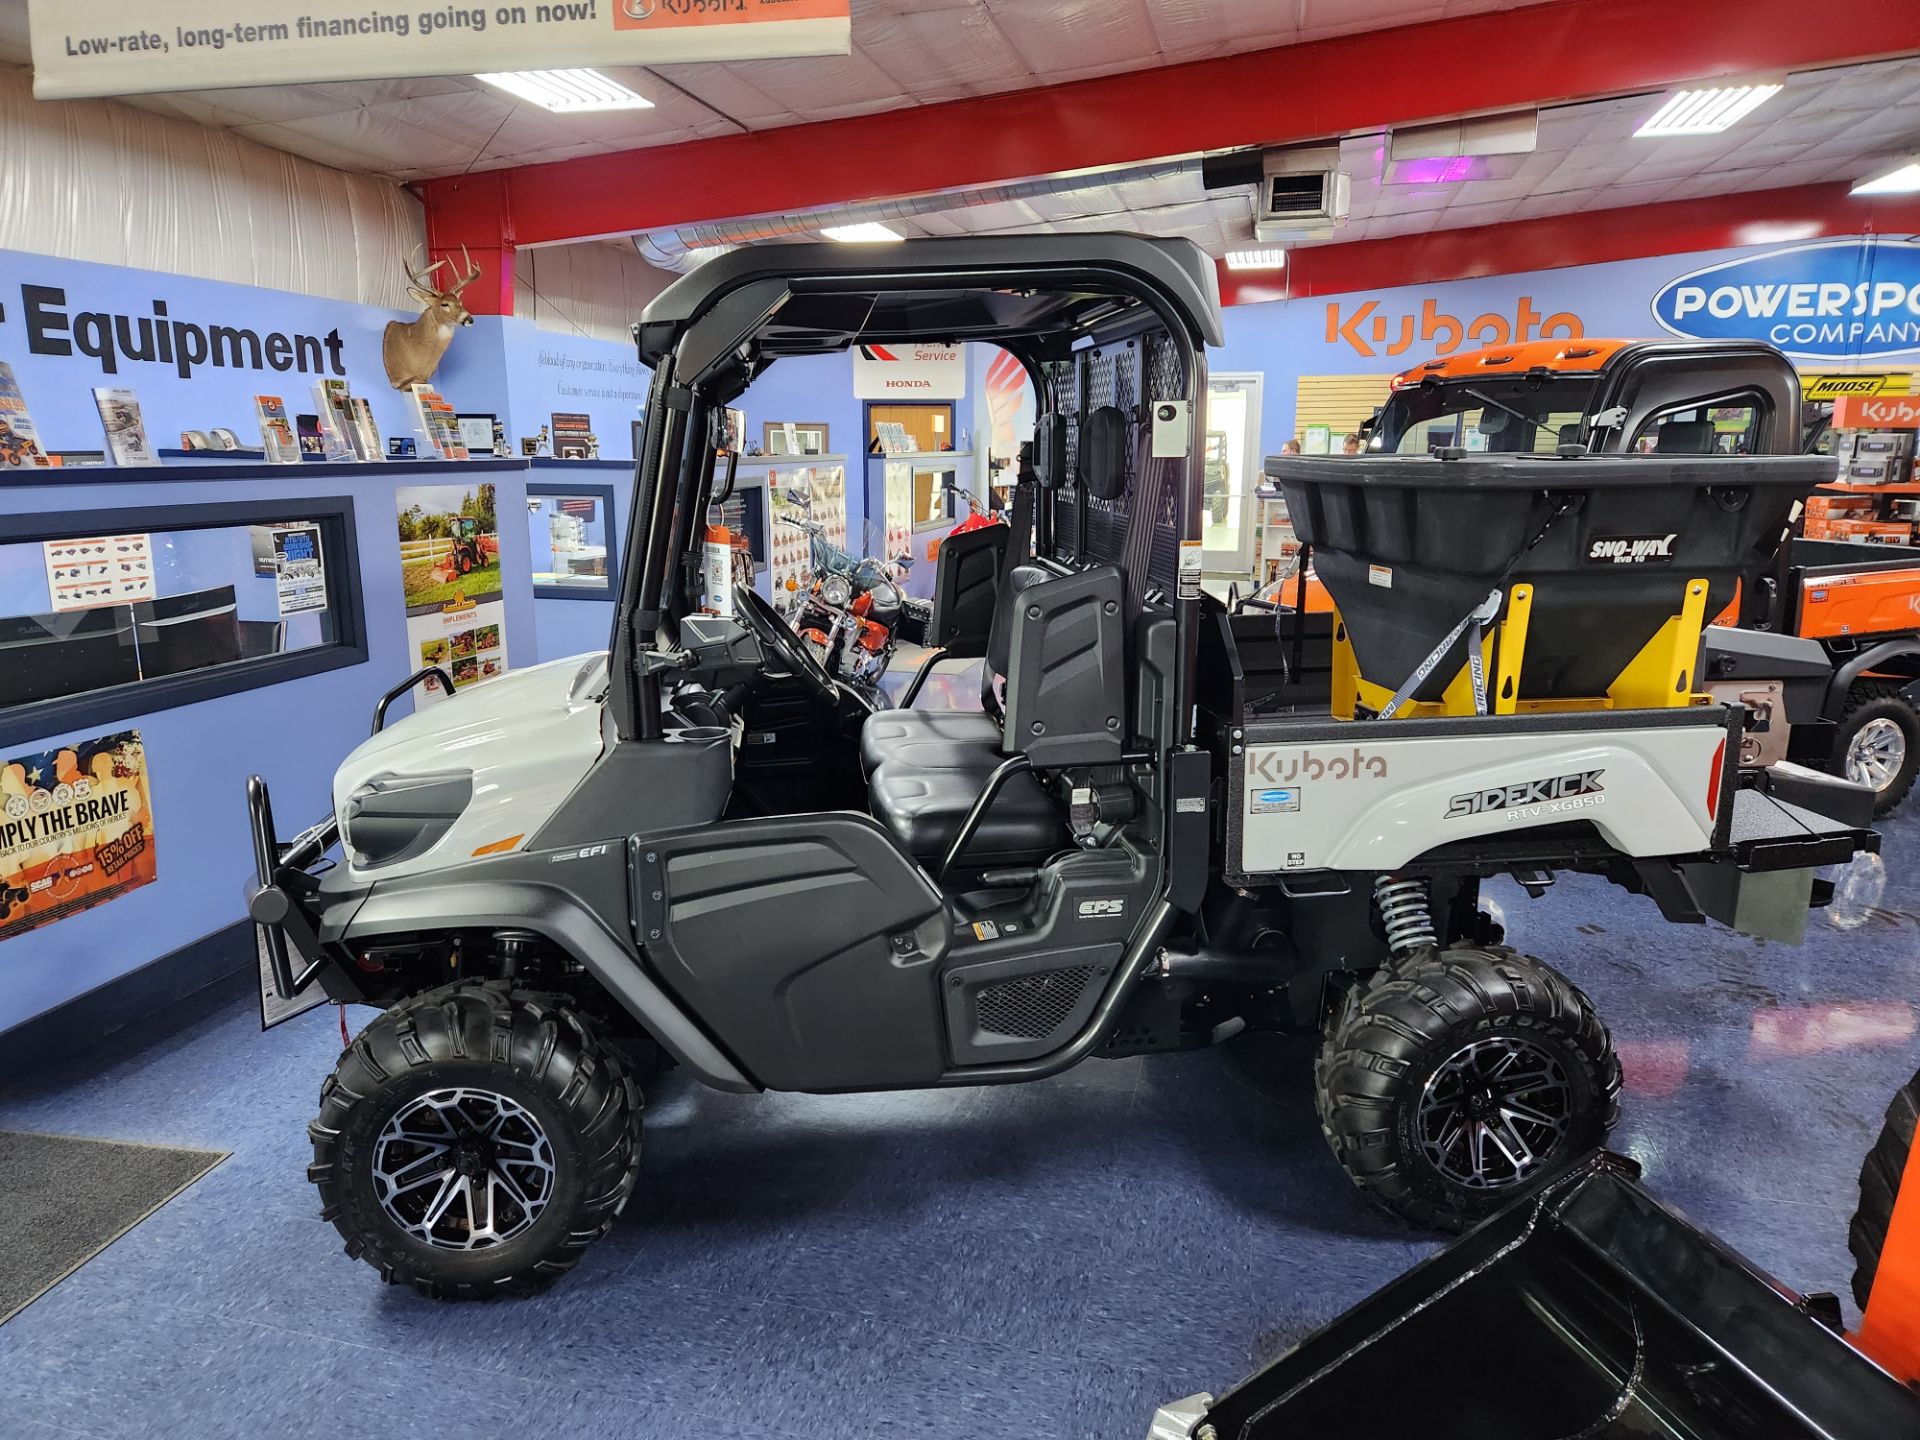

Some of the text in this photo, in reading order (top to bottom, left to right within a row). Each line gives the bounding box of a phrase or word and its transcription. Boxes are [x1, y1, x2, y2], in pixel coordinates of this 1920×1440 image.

[66, 1, 597, 56] Low-rate, long-term financing going on now!
[21, 284, 346, 378] Equipment
[1326, 297, 1584, 356] Kubota
[914, 350, 956, 361] Service
[557, 380, 583, 397] Customer
[885, 380, 931, 388] HONDA
[1816, 381, 1879, 392] MOOSE
[443, 611, 477, 625] IMPLEMENTS
[1416, 637, 1453, 681] RACING
[1470, 656, 1486, 707] RACING
[1250, 749, 1387, 783] Kubota
[1444, 769, 1605, 819] SIDEKICK
[1507, 794, 1606, 823] RTV-XG850
[39, 806, 75, 836] THE
[75, 790, 129, 826] BRAVE
[0, 812, 127, 858] BACK TO OUR COUNTRY'S MILLIONS OF HEROES
[98, 826, 143, 867] 15% OFF
[579, 844, 608, 858] EFI
[106, 858, 124, 874] RETAIL
[1079, 899, 1124, 915] EPS
